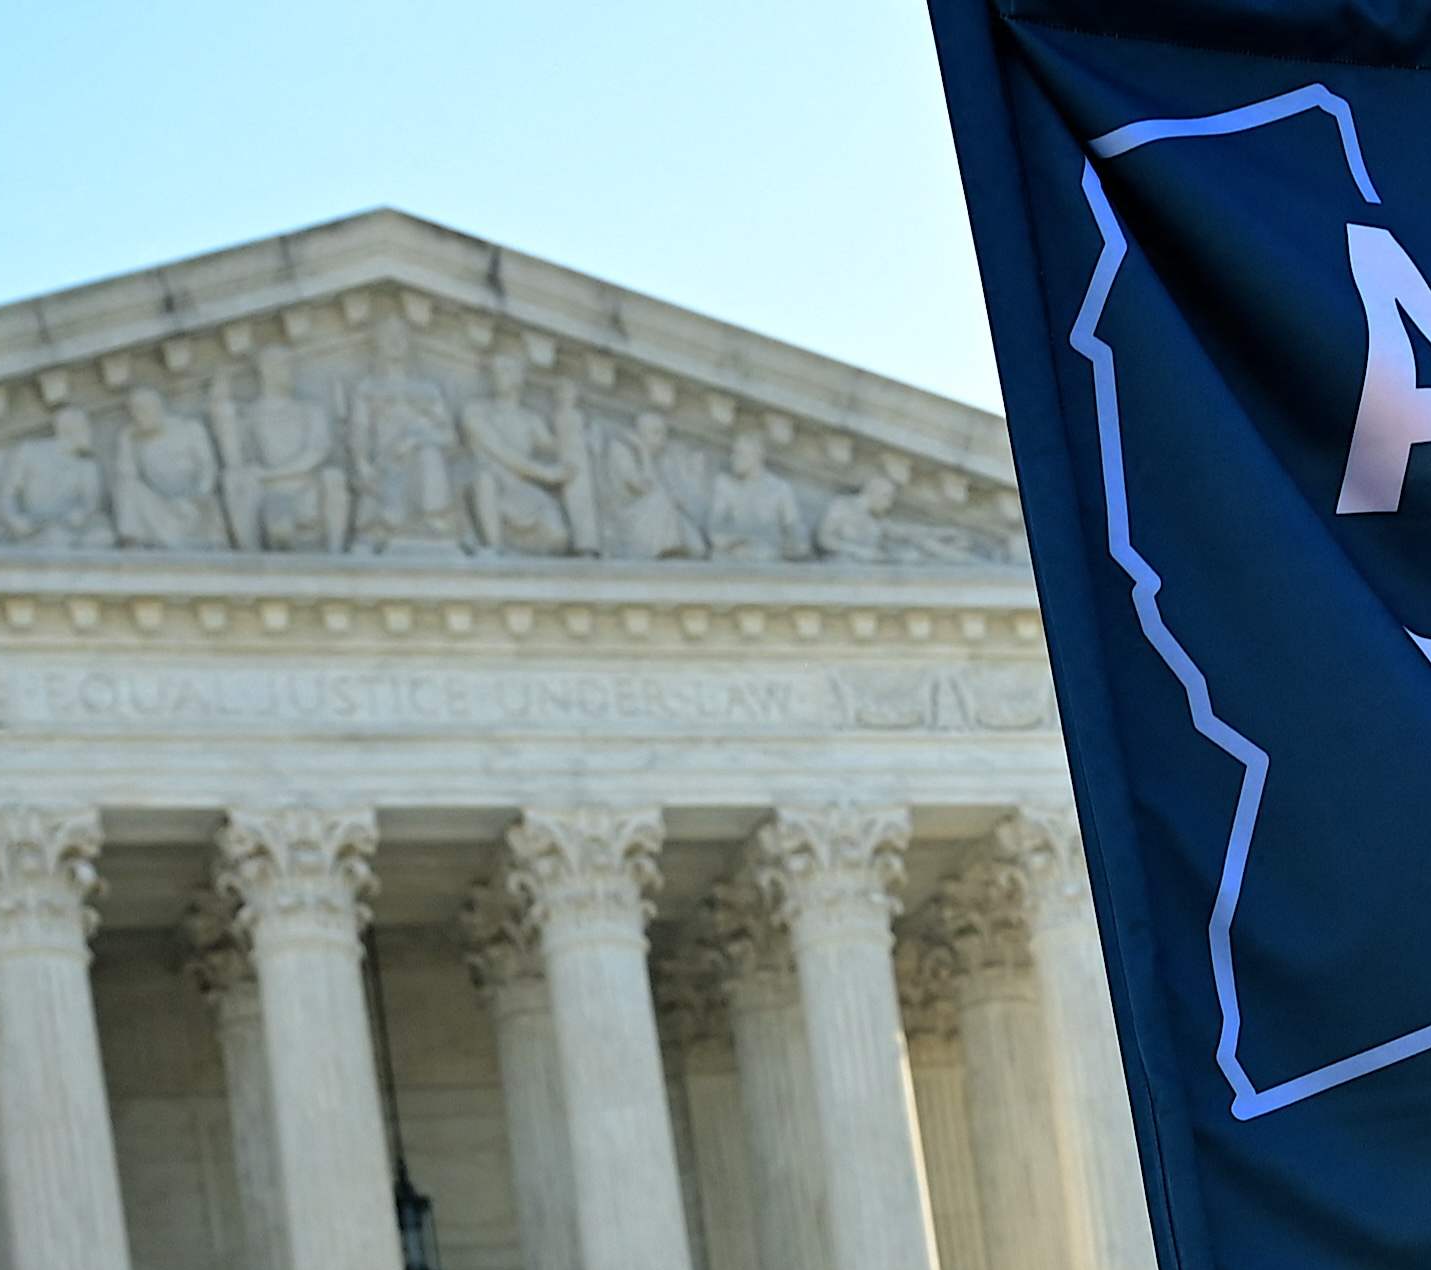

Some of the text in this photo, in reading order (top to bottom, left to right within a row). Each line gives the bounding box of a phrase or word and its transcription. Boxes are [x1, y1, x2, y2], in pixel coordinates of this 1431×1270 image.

[255, 677, 468, 720] JUSTICE
[501, 678, 674, 720] UNDER
[696, 680, 792, 719] LAW
